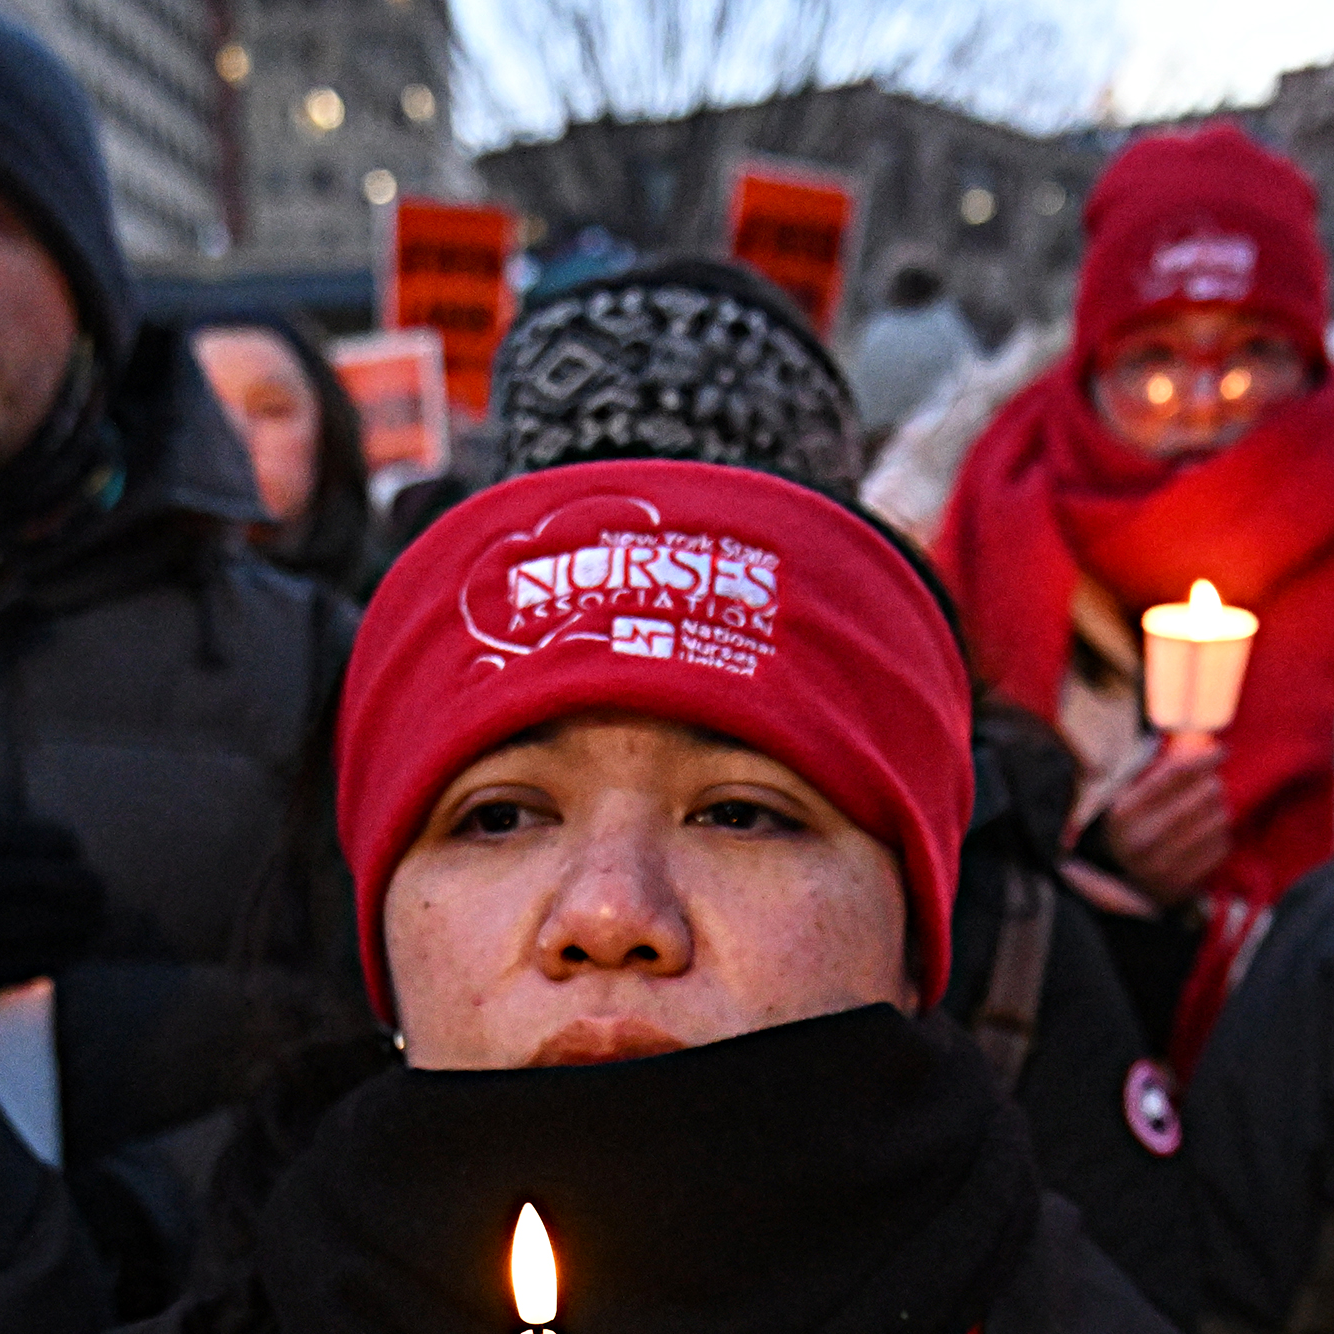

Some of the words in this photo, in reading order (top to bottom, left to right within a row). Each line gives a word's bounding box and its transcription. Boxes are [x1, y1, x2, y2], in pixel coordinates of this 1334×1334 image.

[507, 546, 778, 609] NURSES
[680, 634, 758, 668] Nurses
[681, 618, 776, 656] National
